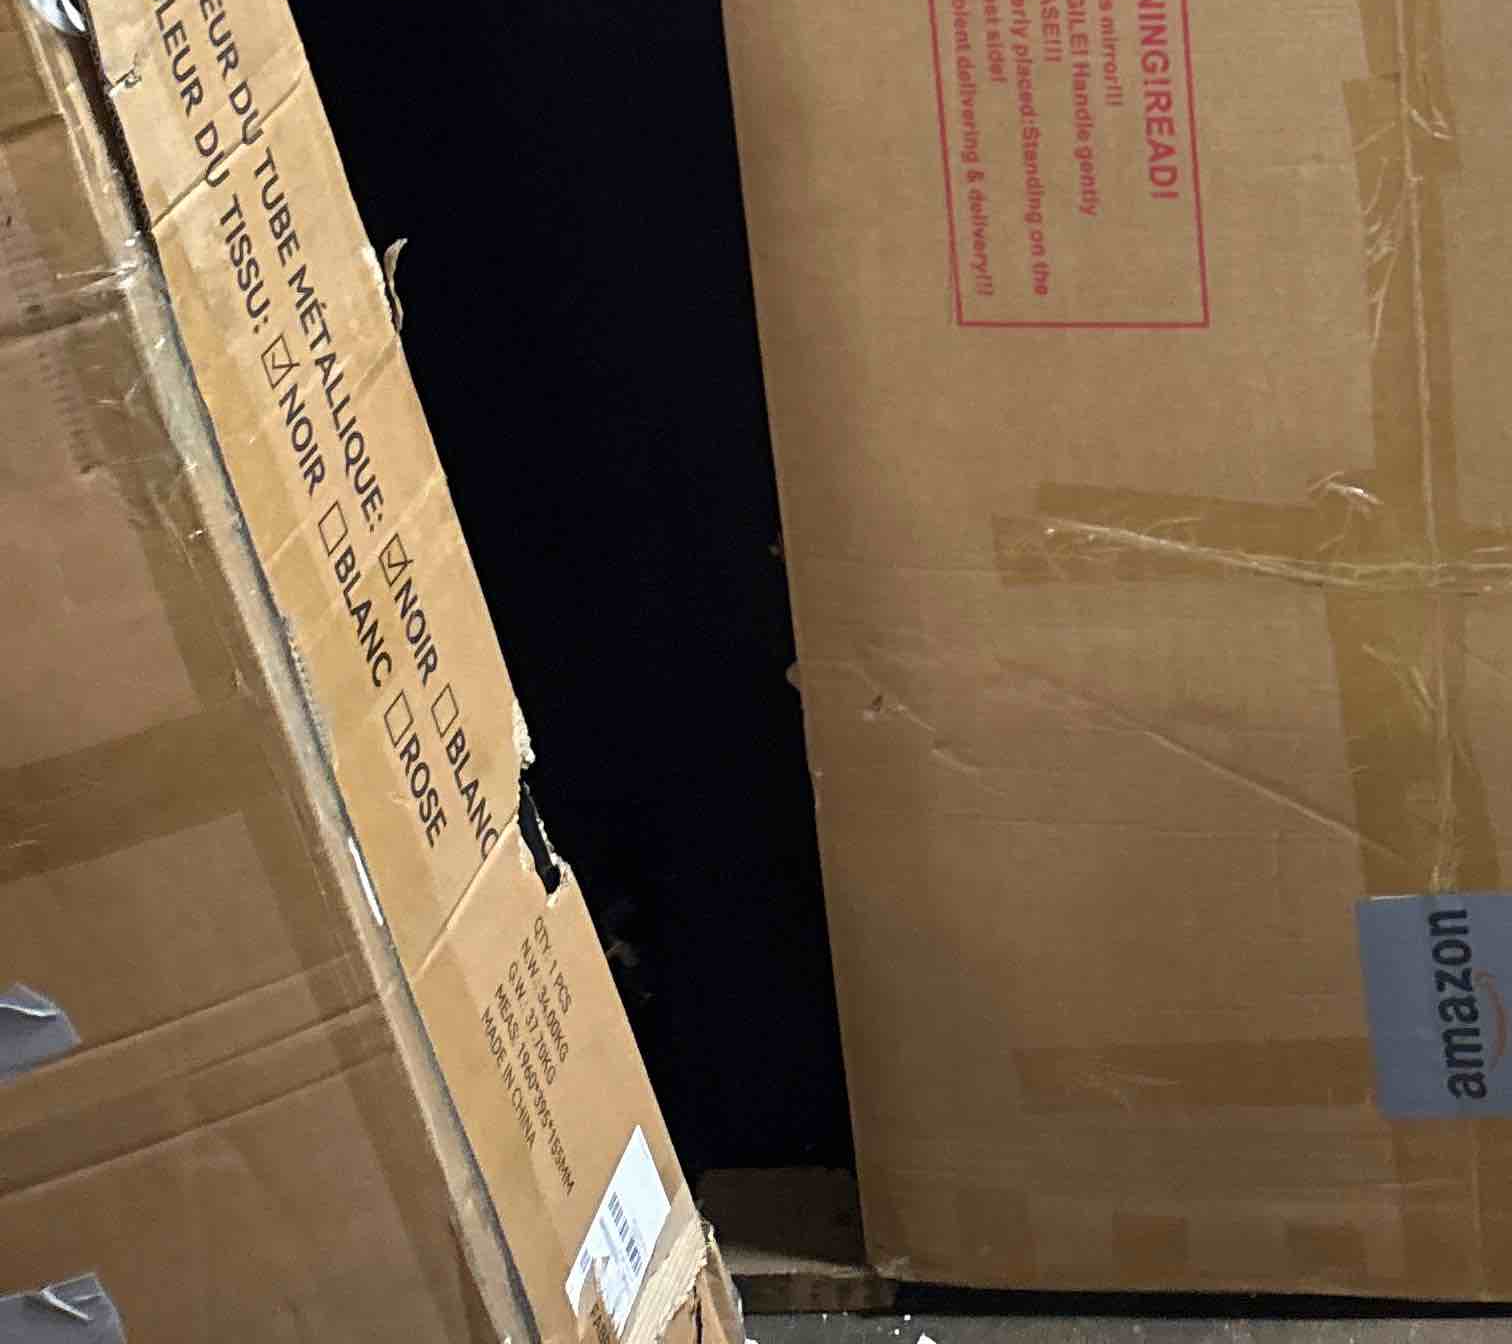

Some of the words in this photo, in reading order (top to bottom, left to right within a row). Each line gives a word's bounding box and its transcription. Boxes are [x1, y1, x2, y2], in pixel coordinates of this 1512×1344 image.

[987, 30, 1008, 84] side!
[1072, 63, 1094, 141] Handle
[1100, 16, 1124, 107] mirror!!!
[957, 56, 980, 164] delivering
[1074, 145, 1100, 217] gently
[968, 189, 994, 296] delivery!!!
[1029, 230, 1046, 257] on
[1032, 261, 1050, 296] the
[193, 119, 231, 189] DU
[219, 193, 271, 335] TISSU:
[278, 382, 326, 497] NOIR
[333, 543, 393, 689] BLANC
[398, 733, 448, 849] ROSE
[228, 79, 265, 146] DU
[254, 145, 301, 269] TUBE
[287, 262, 386, 534] MÉTALLIQUE:
[394, 578, 439, 689] NOIR
[445, 726, 499, 861] BLANC
[553, 971, 572, 1015] PCS
[1428, 909, 1488, 1100] amazon
[480, 1007, 506, 1069] MADE
[503, 1063, 515, 1091] IN
[512, 1087, 536, 1151] CHINA
